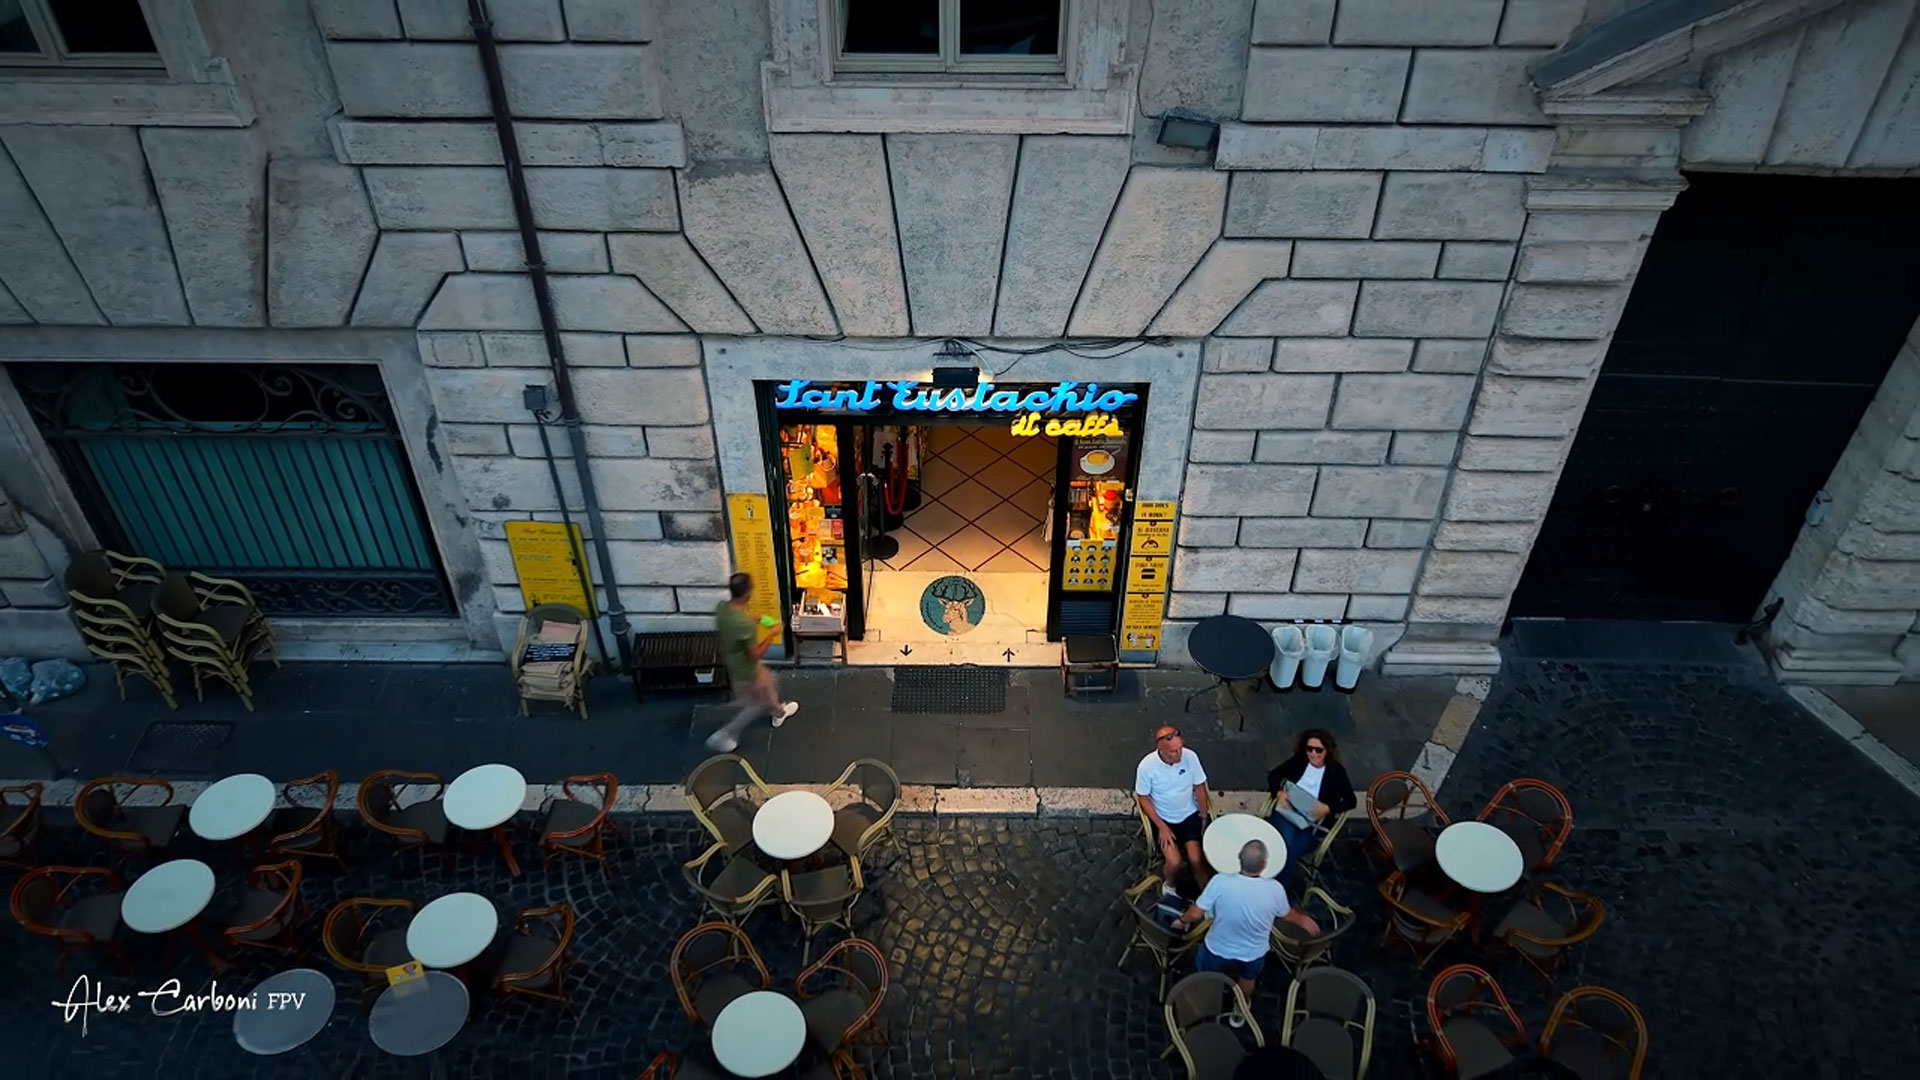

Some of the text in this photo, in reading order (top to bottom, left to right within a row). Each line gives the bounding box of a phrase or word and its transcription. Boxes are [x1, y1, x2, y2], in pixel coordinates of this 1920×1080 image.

[775, 379, 1138, 412] Sant Eustachio
[1010, 411, 1042, 437] il
